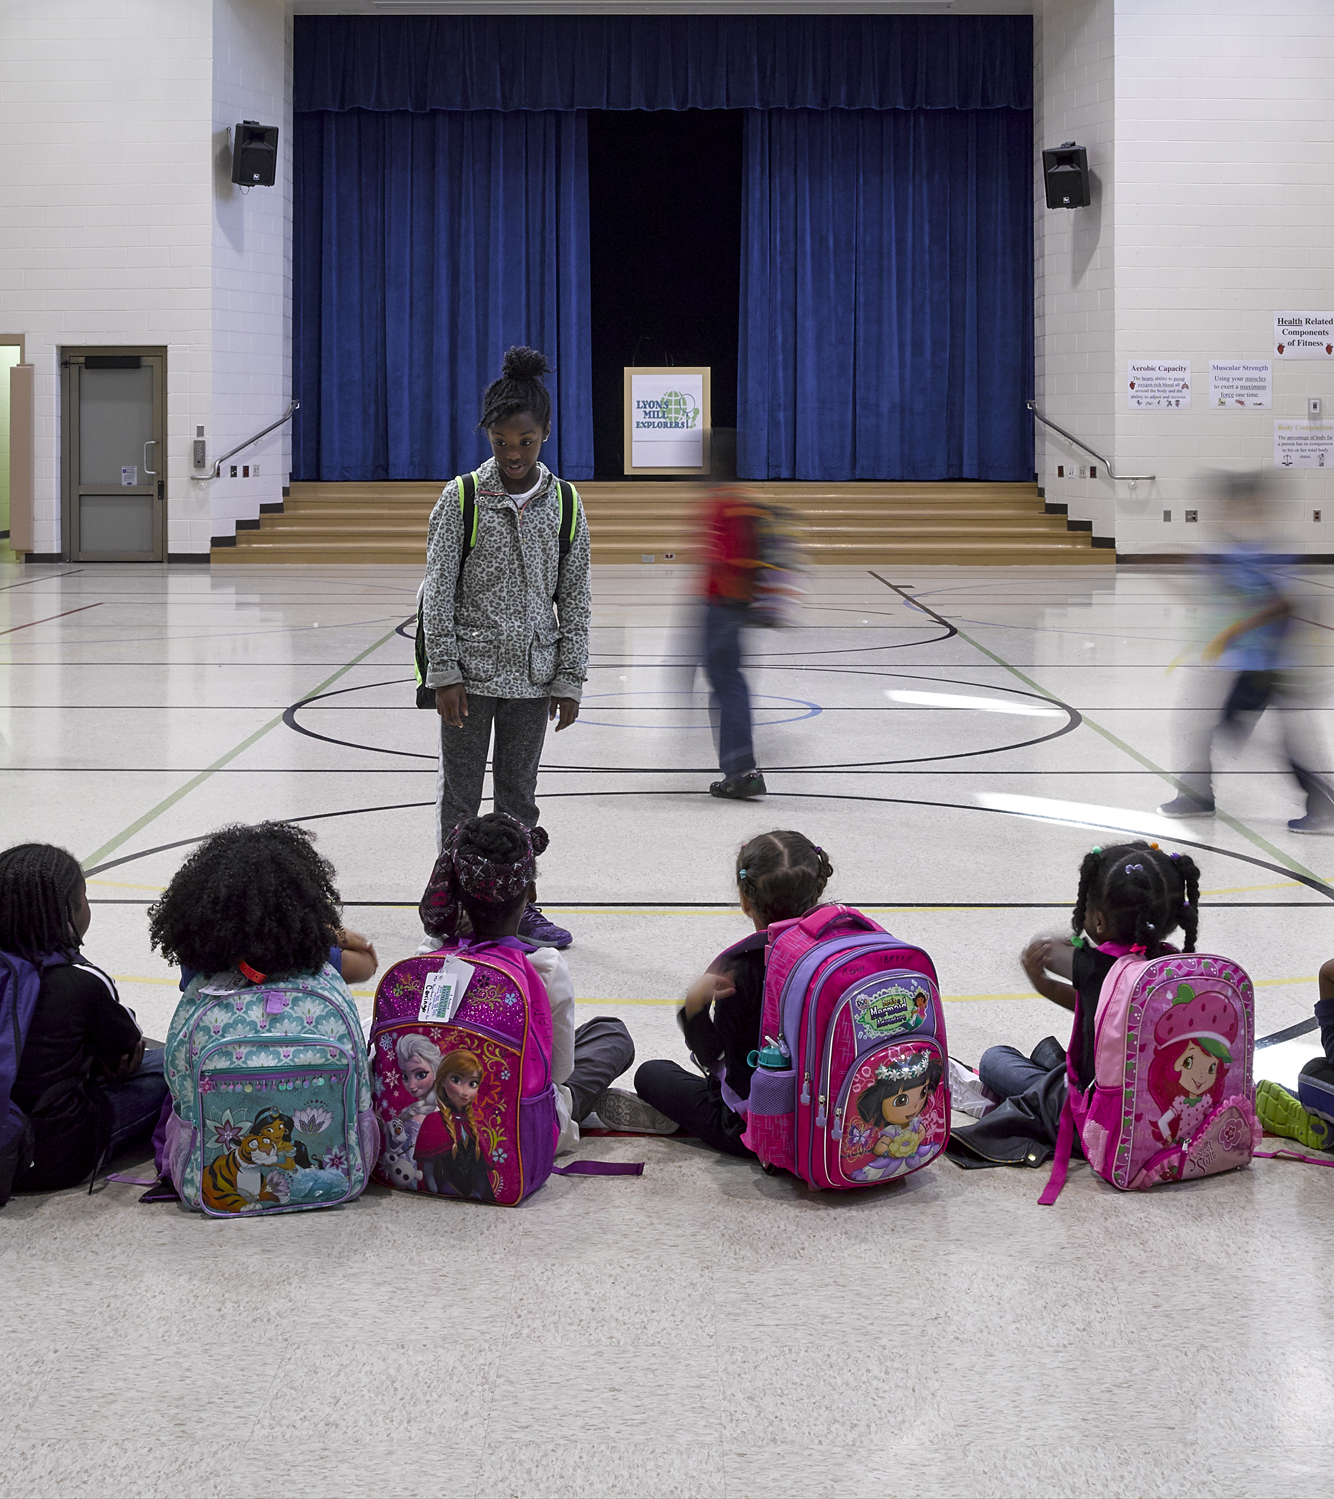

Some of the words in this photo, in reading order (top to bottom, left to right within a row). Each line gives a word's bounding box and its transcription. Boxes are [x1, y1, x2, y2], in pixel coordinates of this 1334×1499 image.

[1277, 317, 1303, 326] Health
[1305, 317, 1334, 325] Related
[1282, 328, 1329, 337] Components
[1287, 339, 1296, 347] of
[1297, 339, 1324, 347] Fitness
[1158, 365, 1187, 373] Capacity
[636, 400, 669, 409] LYONS
[643, 410, 668, 419] MILL
[636, 421, 685, 429] EXPLORERS
[869, 997, 907, 1019] Mermaid
